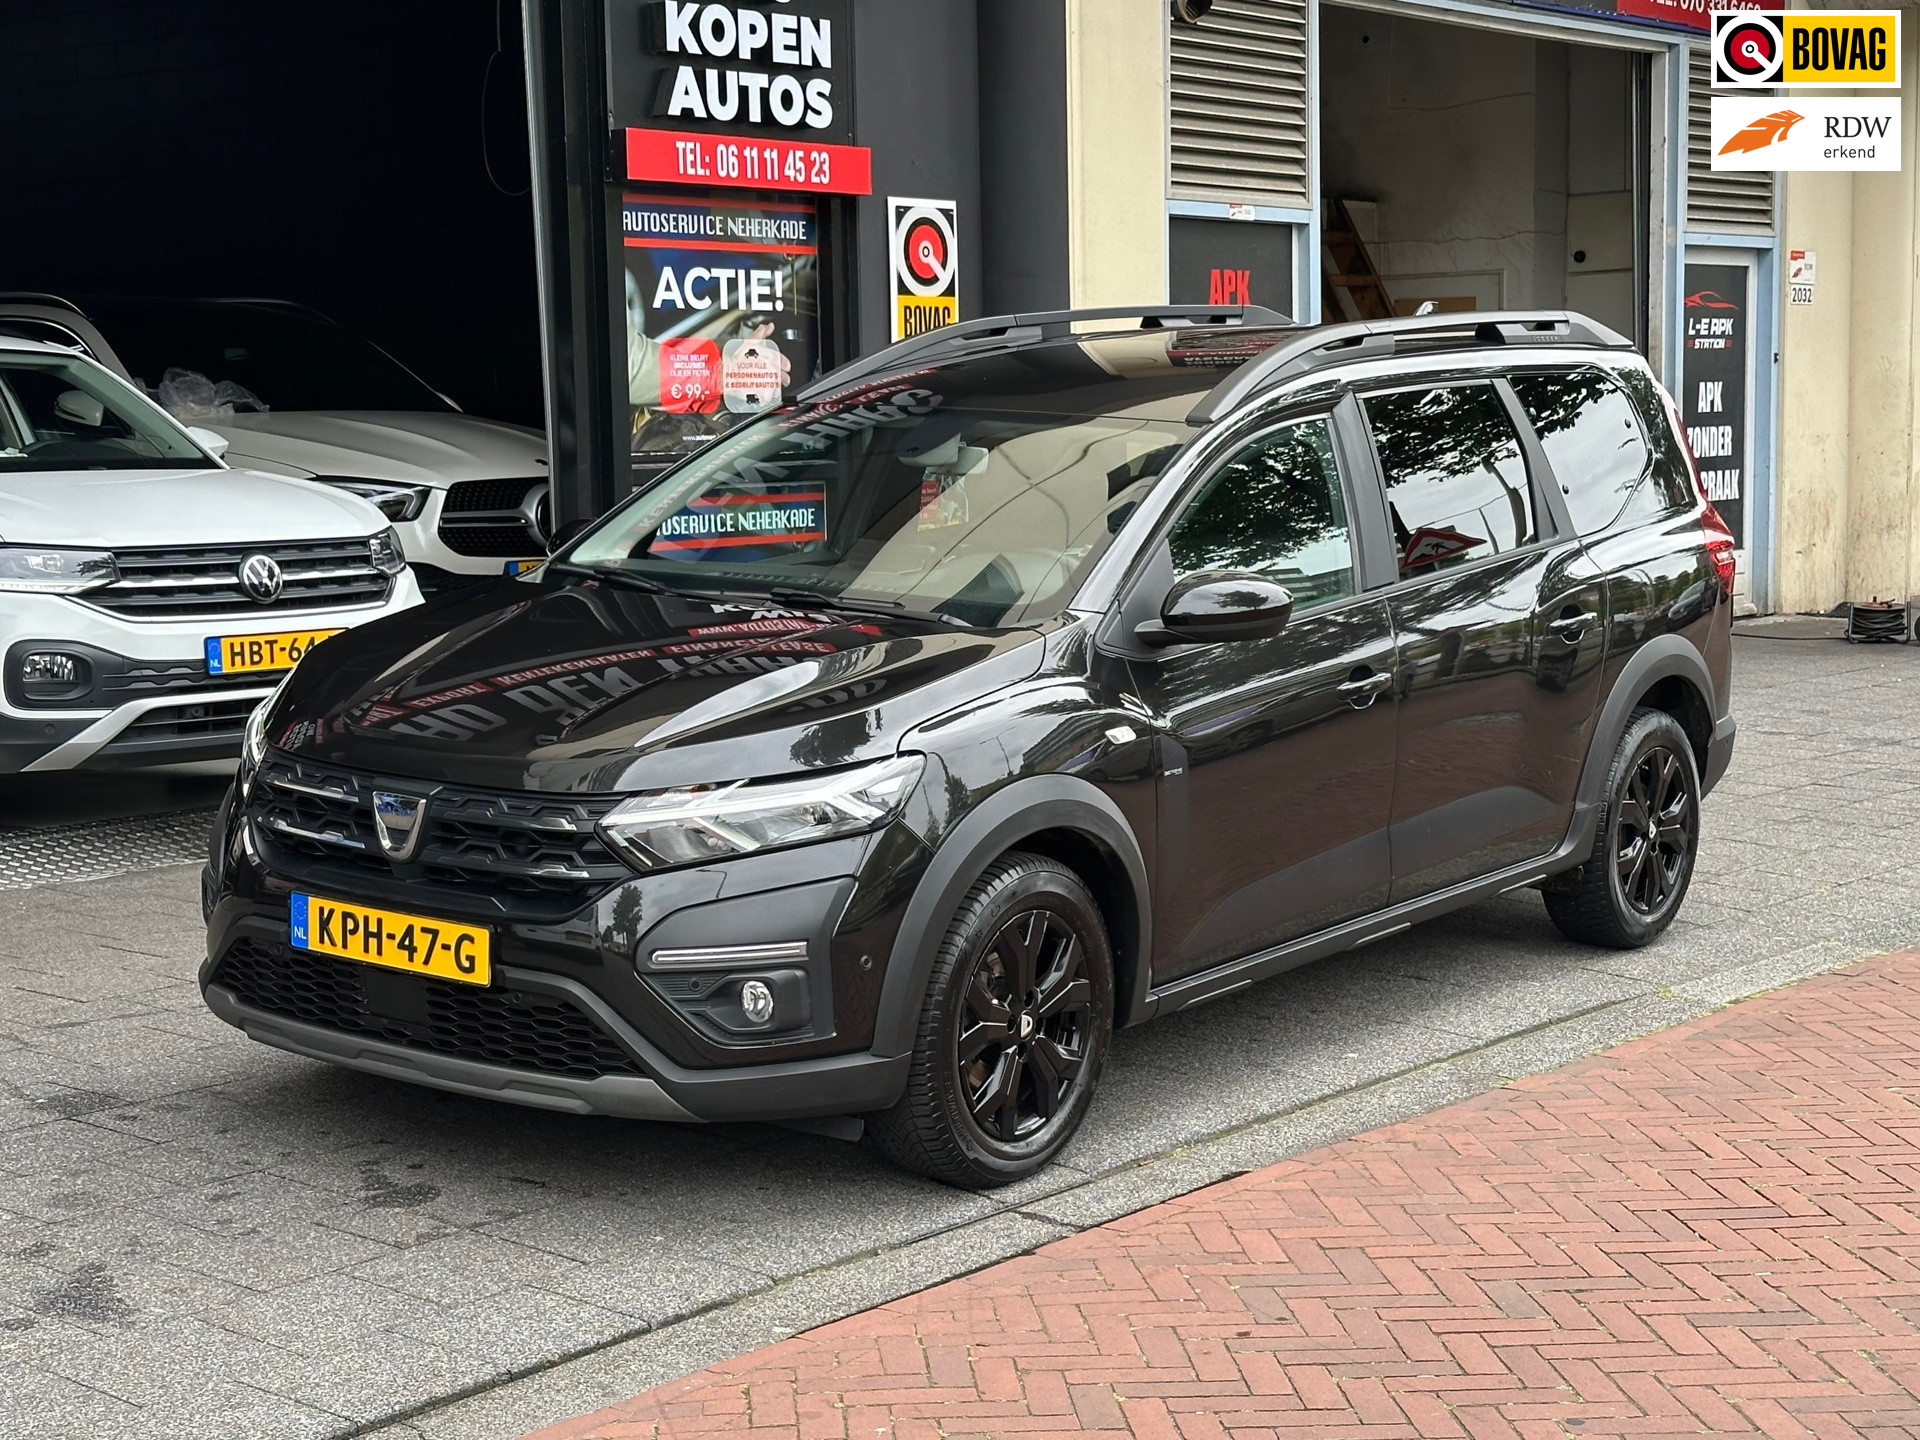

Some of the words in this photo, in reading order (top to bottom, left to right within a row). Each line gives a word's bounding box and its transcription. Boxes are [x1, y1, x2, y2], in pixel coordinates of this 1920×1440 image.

[665, 0, 832, 69] KOPEN
[667, 65, 834, 129] AUTOS
[675, 140, 711, 177] TEL:
[716, 143, 738, 179] 06
[743, 146, 760, 180] 11
[764, 147, 779, 181] 11
[784, 149, 806, 184] 45
[810, 151, 830, 184] 23
[622, 211, 725, 236] AUTOSERVICE
[727, 217, 807, 240] NEHERKADE
[652, 266, 784, 312] ACTIE!
[1208, 269, 1251, 305] APK
[1792, 287, 1812, 303] 2032
[1688, 318, 1710, 335] L-E
[1710, 318, 1734, 335] APK
[725, 371, 779, 379] PERSONENAUTO'S
[671, 384, 682, 399] €
[685, 383, 711, 400] 99,-
[1697, 381, 1723, 413] APK
[1700, 469, 1740, 502] PRAAK
[738, 508, 815, 532] NEHERKADE
[210, 659, 221, 668] NL
[294, 926, 306, 940] NL
[318, 905, 476, 974] KPH-47-G
